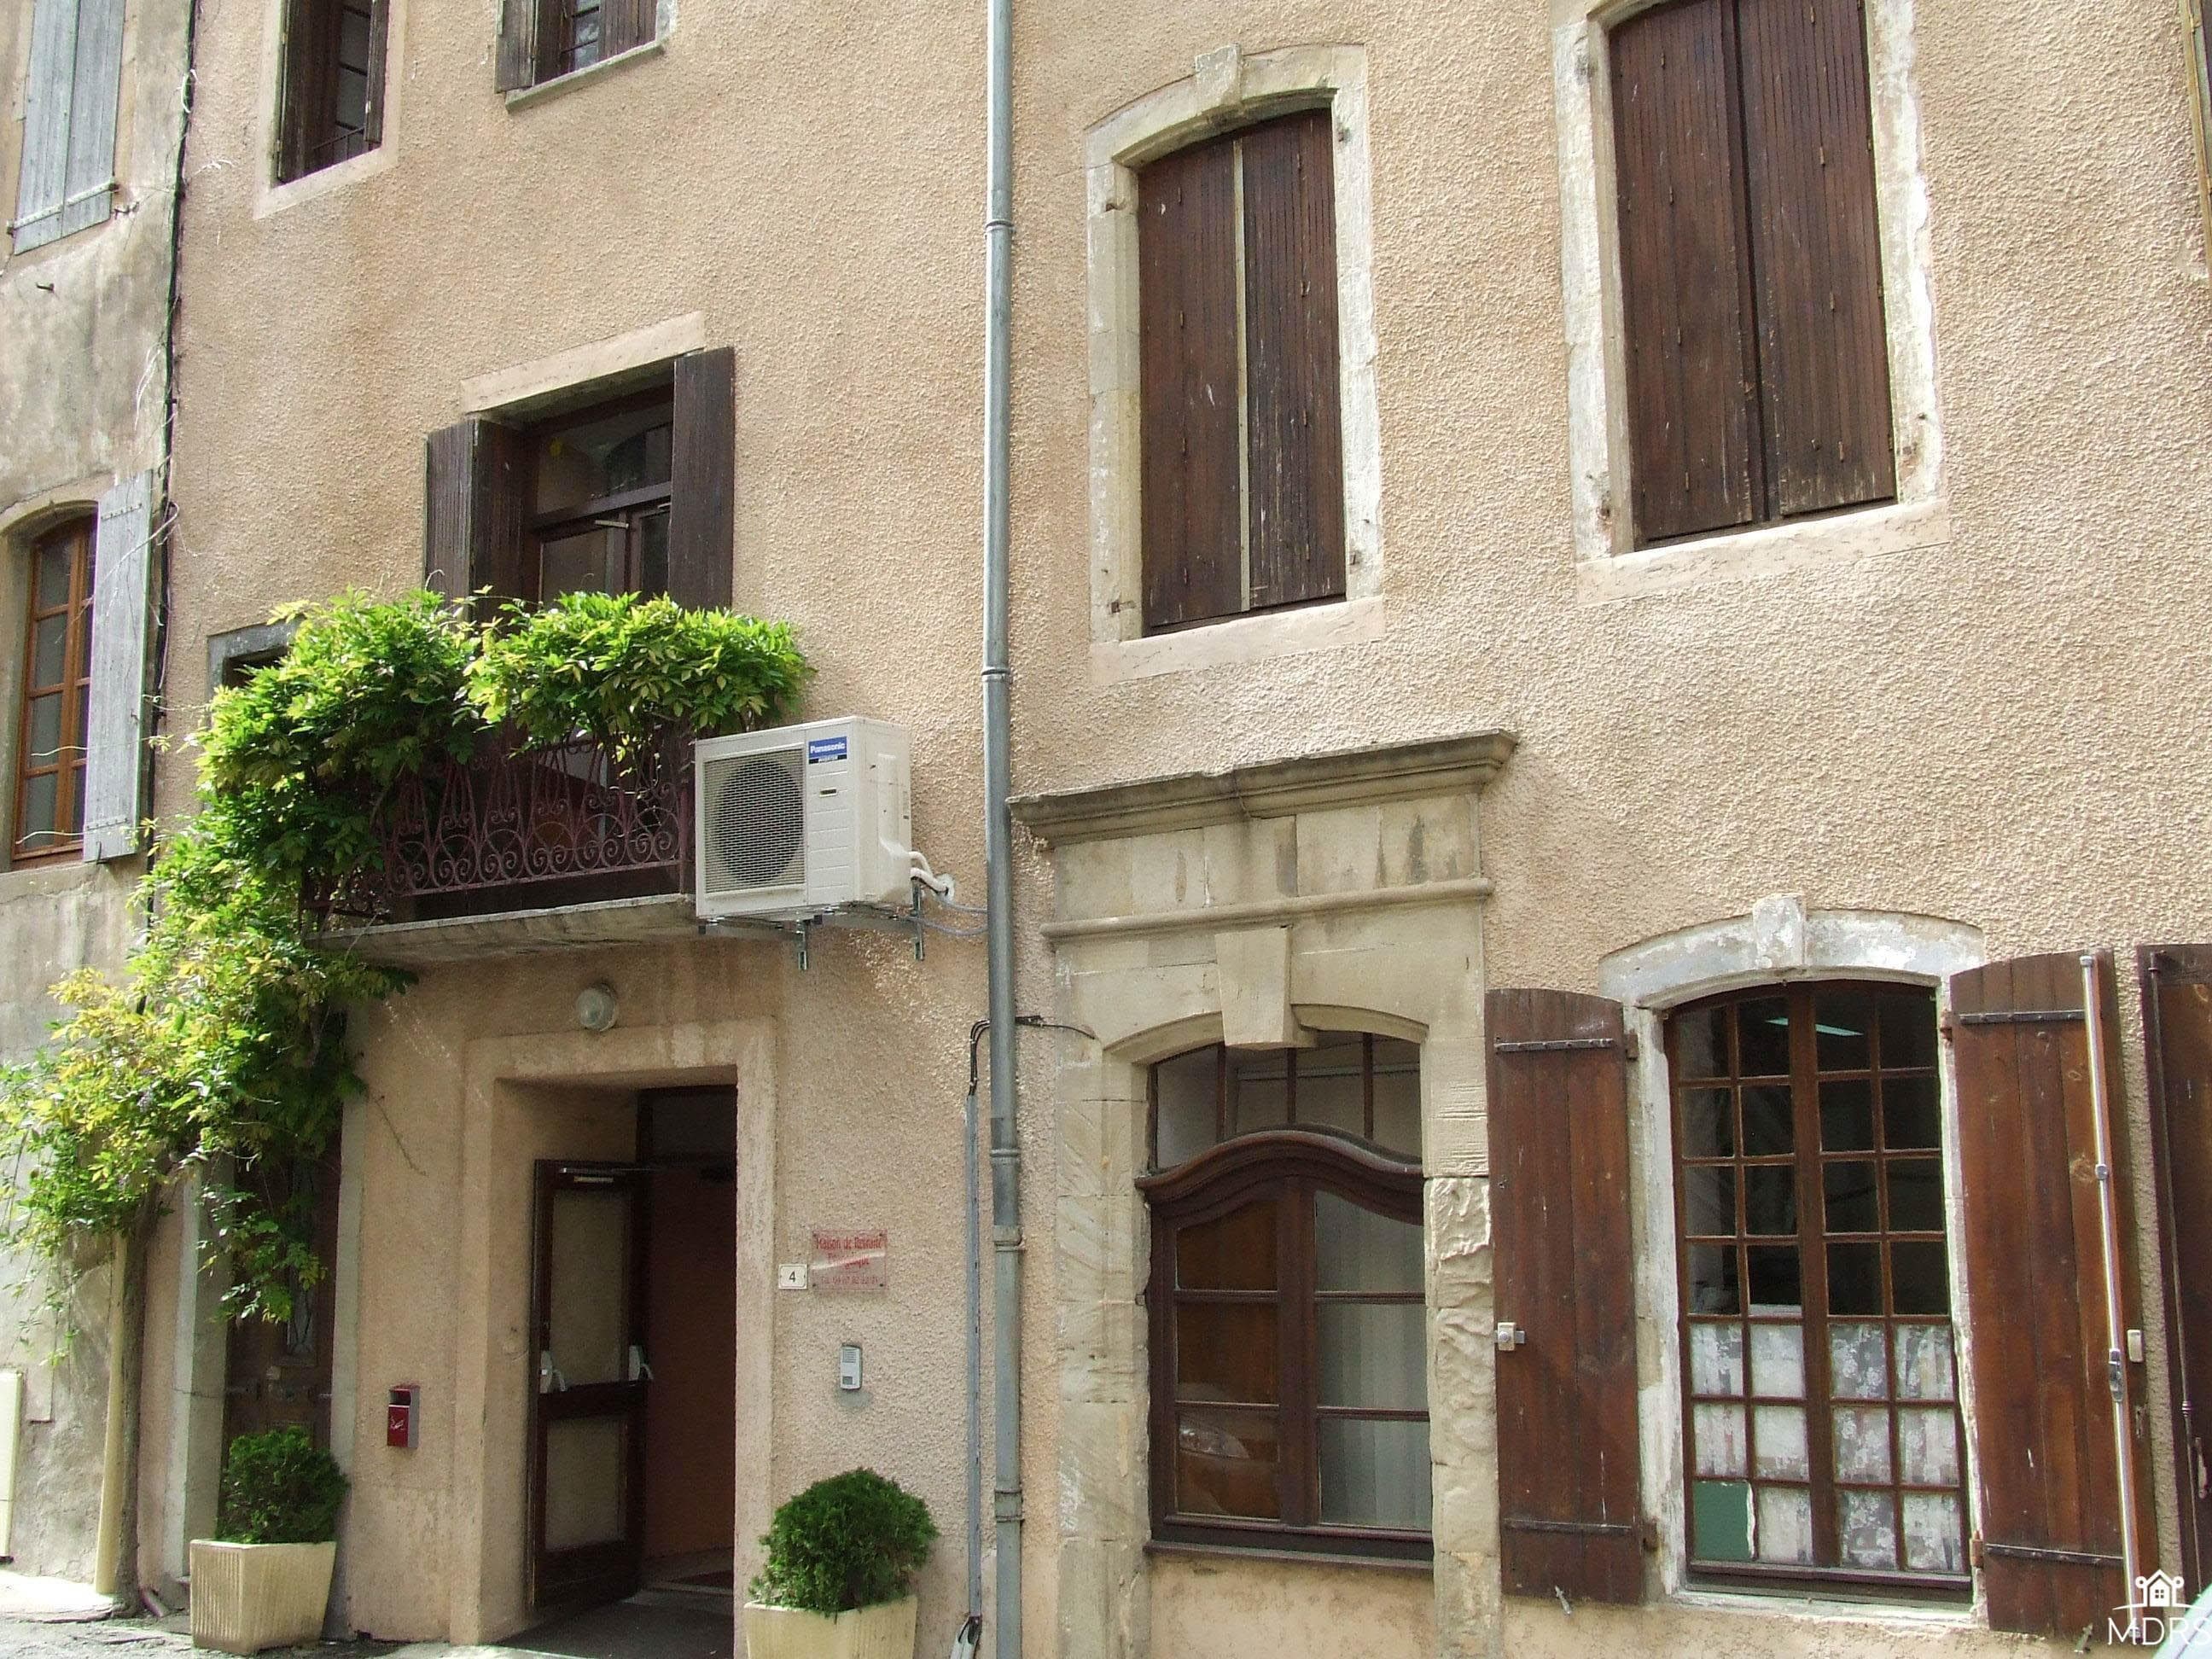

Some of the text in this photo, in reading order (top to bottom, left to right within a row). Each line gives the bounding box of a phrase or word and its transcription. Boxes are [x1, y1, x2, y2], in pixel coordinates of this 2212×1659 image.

[810, 742, 846, 754] Panasonic
[816, 1237, 841, 1250] Maison
[843, 1237, 852, 1249] de
[789, 1271, 796, 1283] 4
